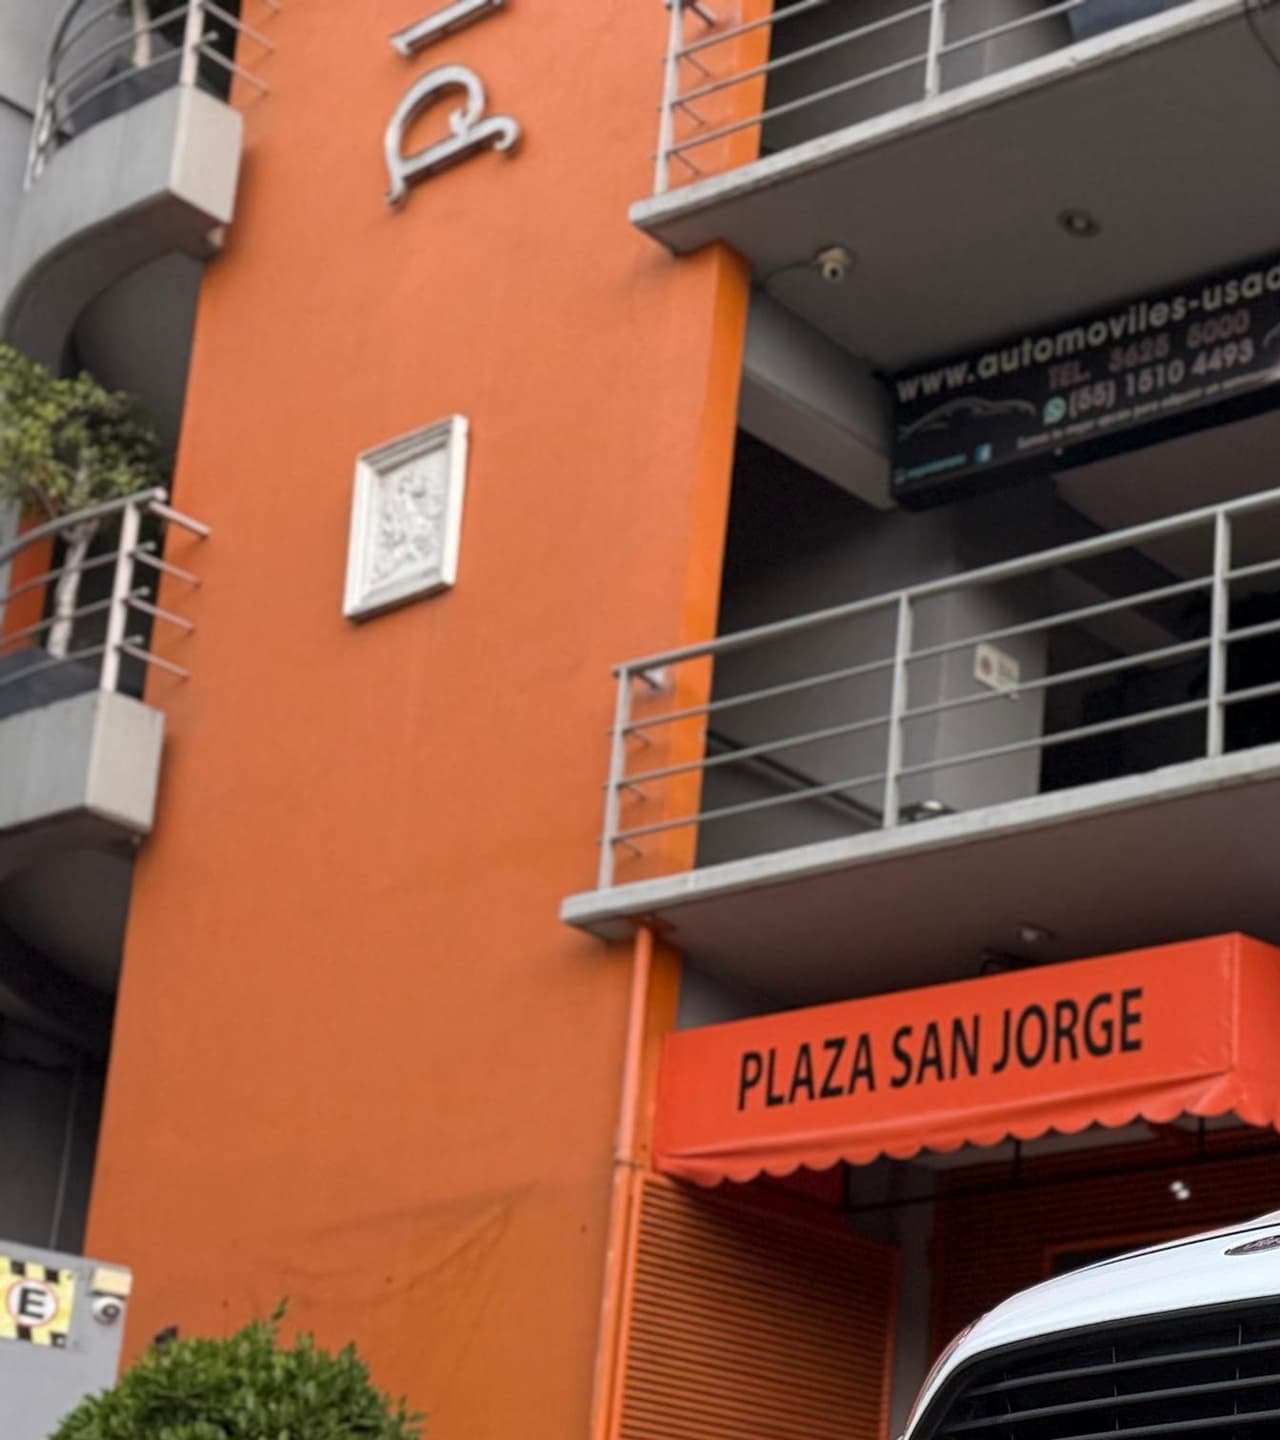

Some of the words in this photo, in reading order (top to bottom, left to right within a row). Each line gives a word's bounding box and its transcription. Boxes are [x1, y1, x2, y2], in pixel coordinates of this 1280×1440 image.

[737, 1031, 876, 1111] PLAZA
[891, 1014, 981, 1088] SAN
[993, 987, 1143, 1074] JORGE
